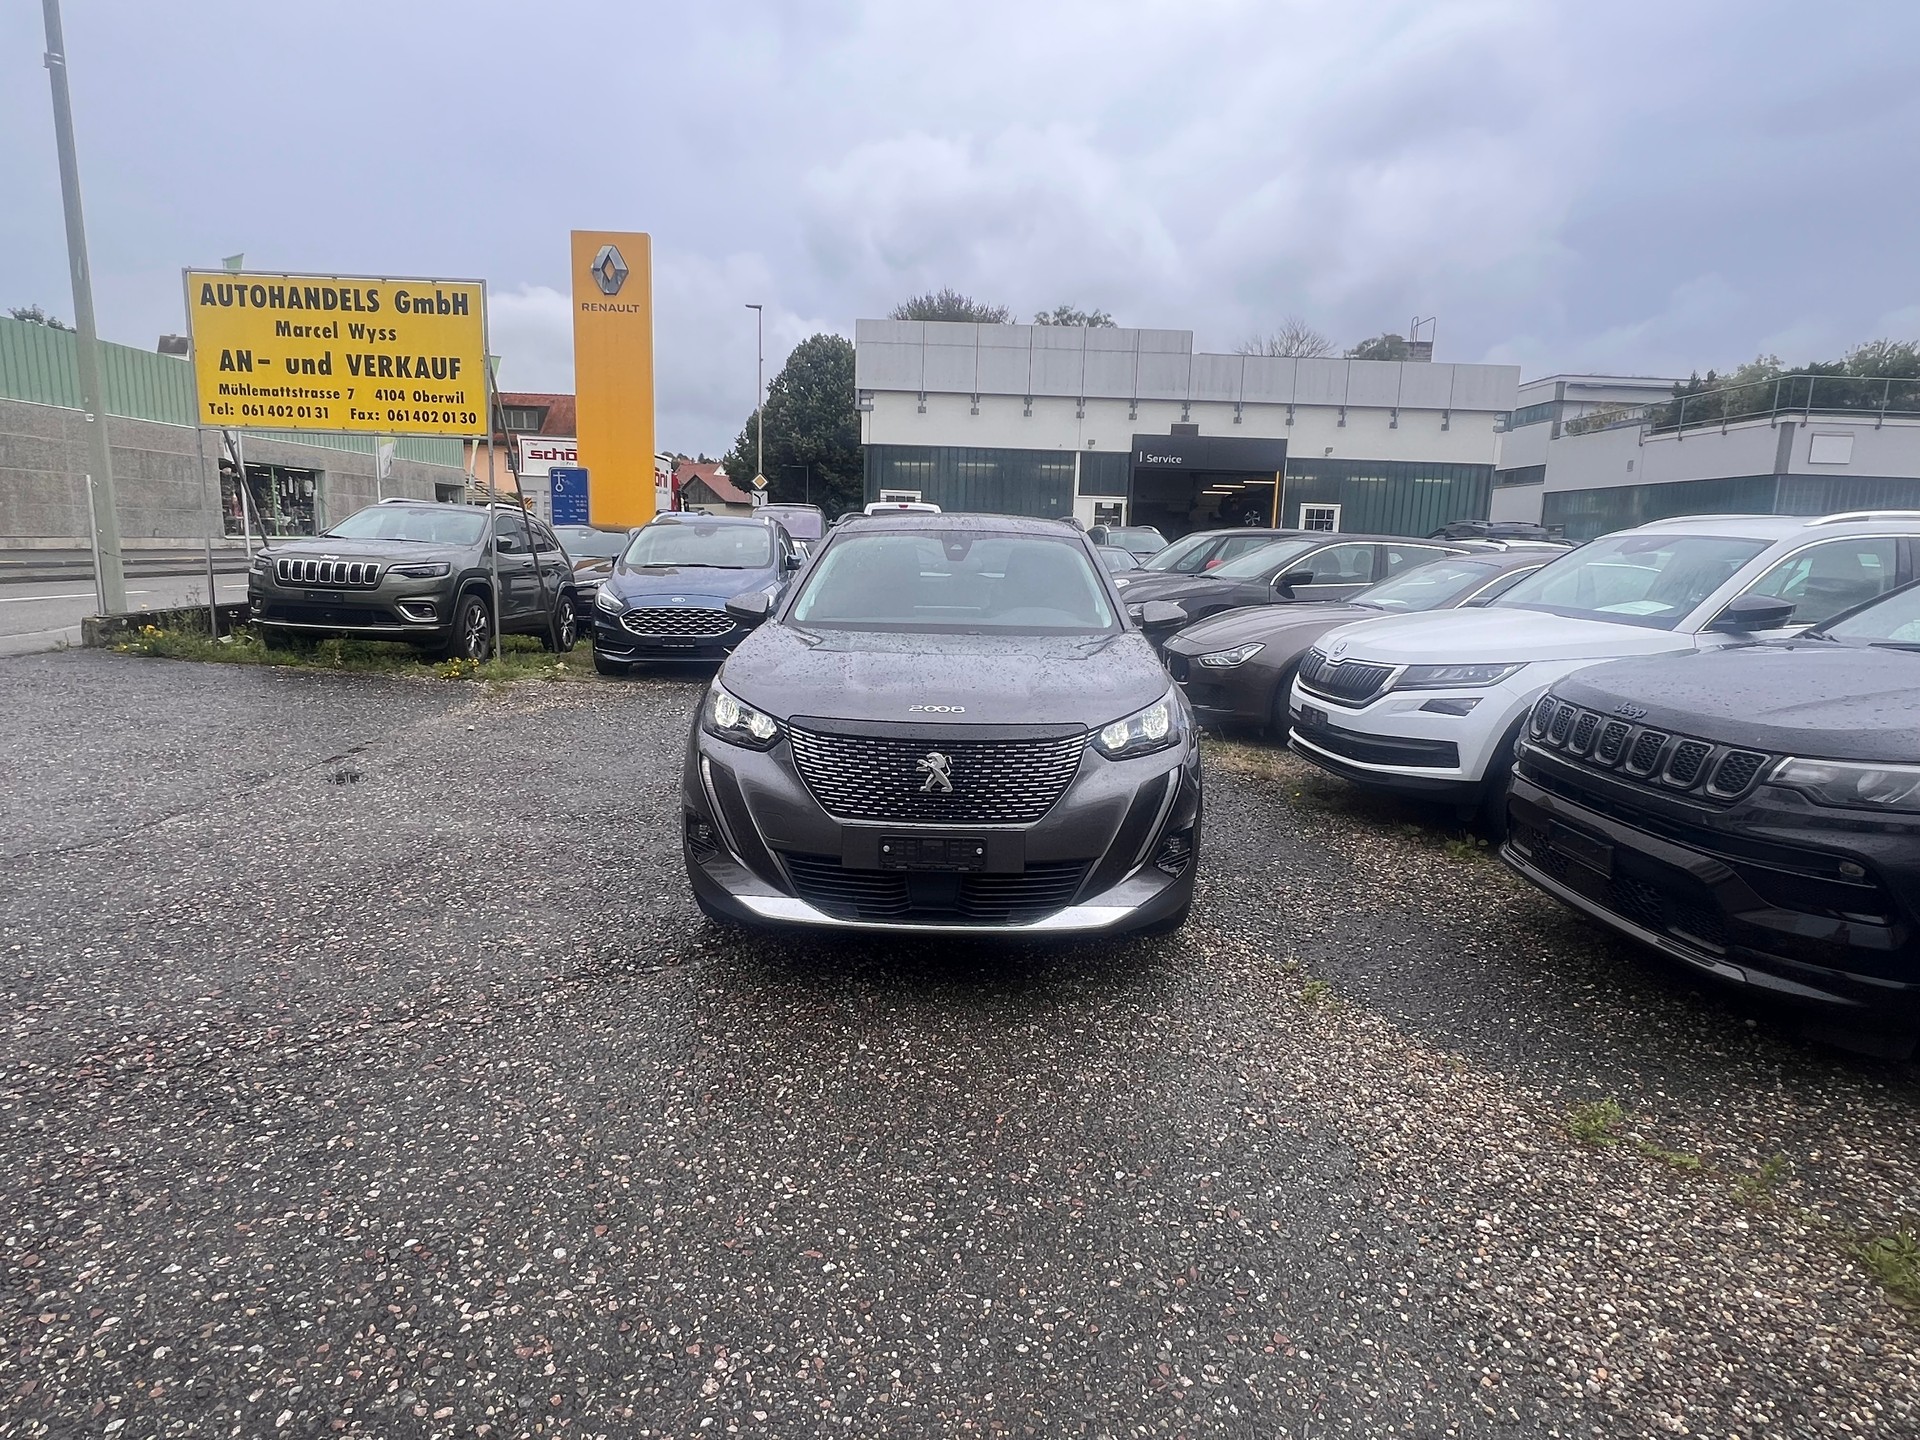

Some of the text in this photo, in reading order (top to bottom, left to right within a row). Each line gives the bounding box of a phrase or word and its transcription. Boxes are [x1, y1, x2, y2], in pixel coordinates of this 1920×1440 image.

[200, 283, 469, 316] AUTOHANDELS GmbH
[581, 302, 640, 313] RENAULT
[275, 320, 397, 344] Marcel Wyss
[285, 350, 333, 375] und
[345, 353, 462, 380] VERKAUF
[218, 383, 465, 404] Mühlemattstrasse 7 4104 Oberwil
[208, 402, 234, 416] Tel:
[350, 408, 380, 421] Fax:
[527, 447, 577, 461] schö
[1146, 454, 1182, 464] Service
[908, 704, 966, 714] 2008
[1614, 701, 1648, 720] Jeep
